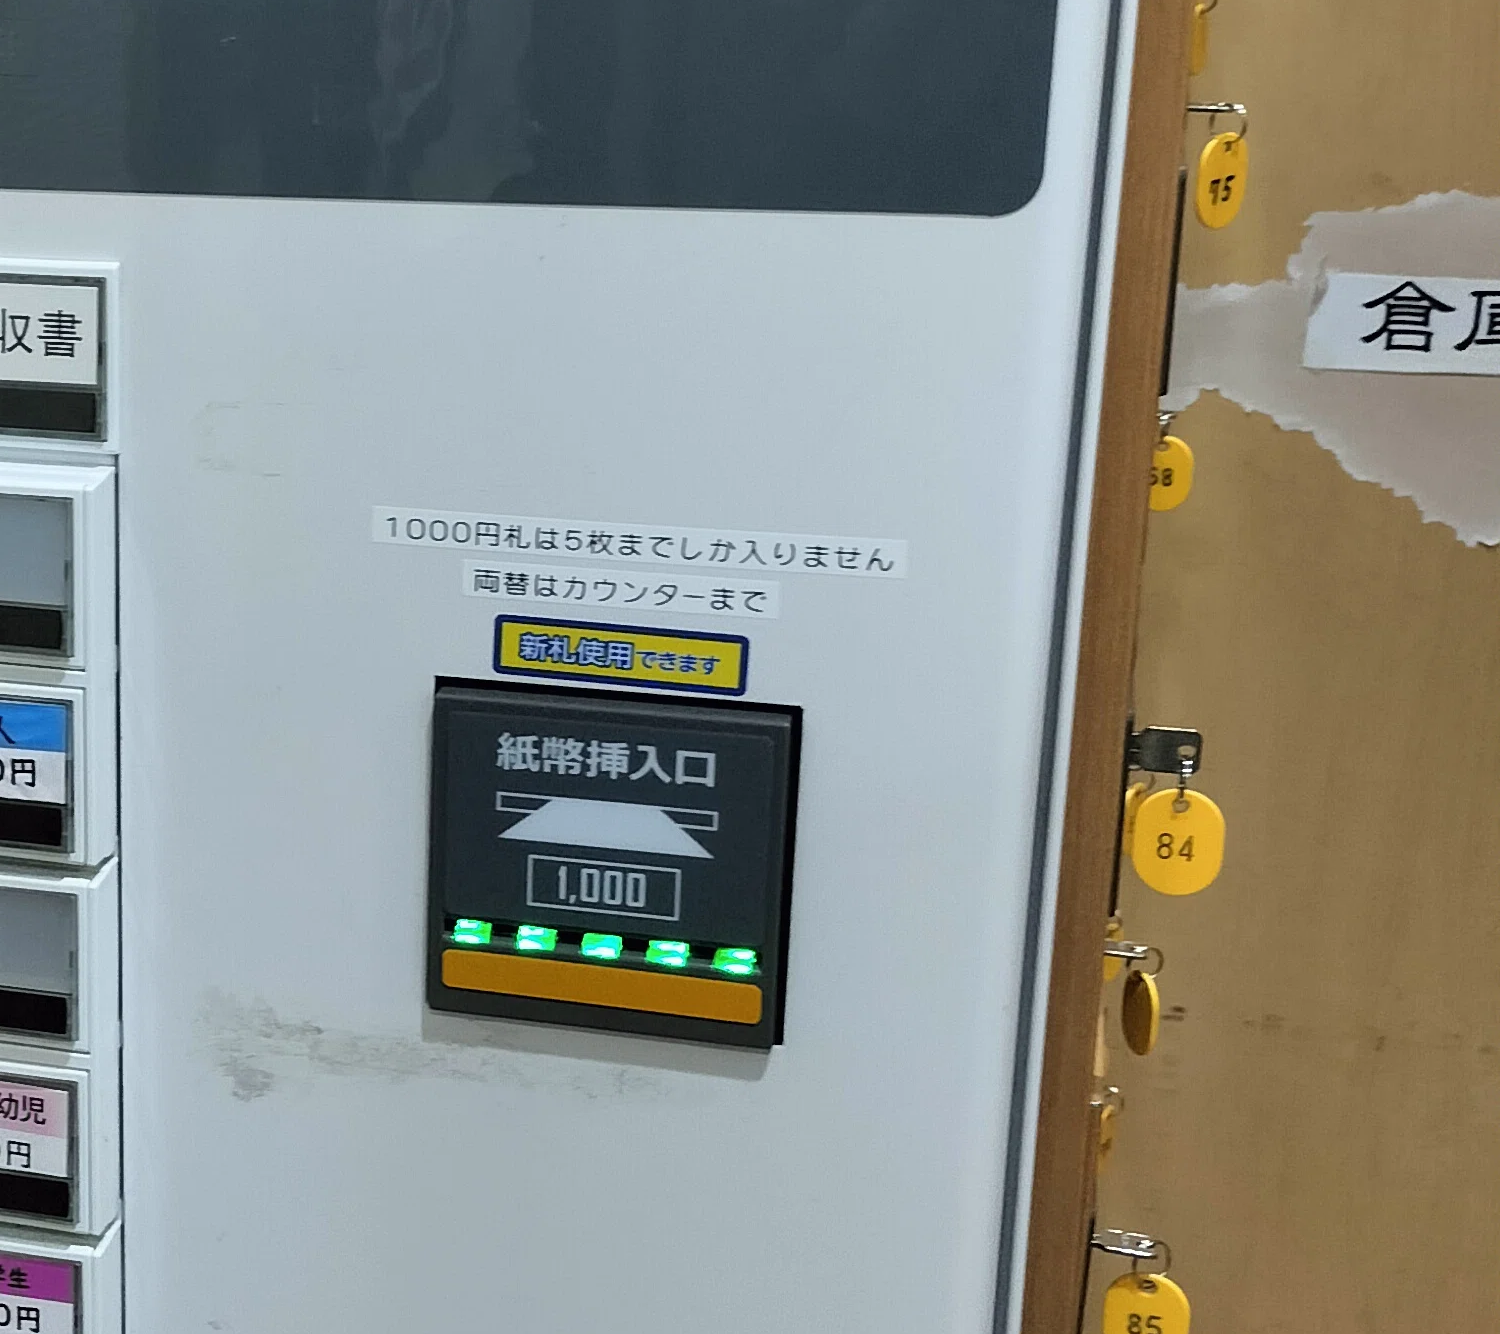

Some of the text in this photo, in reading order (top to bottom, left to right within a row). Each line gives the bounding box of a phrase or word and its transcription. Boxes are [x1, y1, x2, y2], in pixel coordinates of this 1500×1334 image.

[385, 515, 895, 572] 1000円札は5枚までしか入りません
[473, 569, 768, 613] 両替はカウンターまで
[520, 633, 721, 676] 新札使用できます
[496, 732, 716, 788] 紙幣挿入口
[1157, 833, 1194, 861] 84
[558, 866, 646, 908] 1,000
